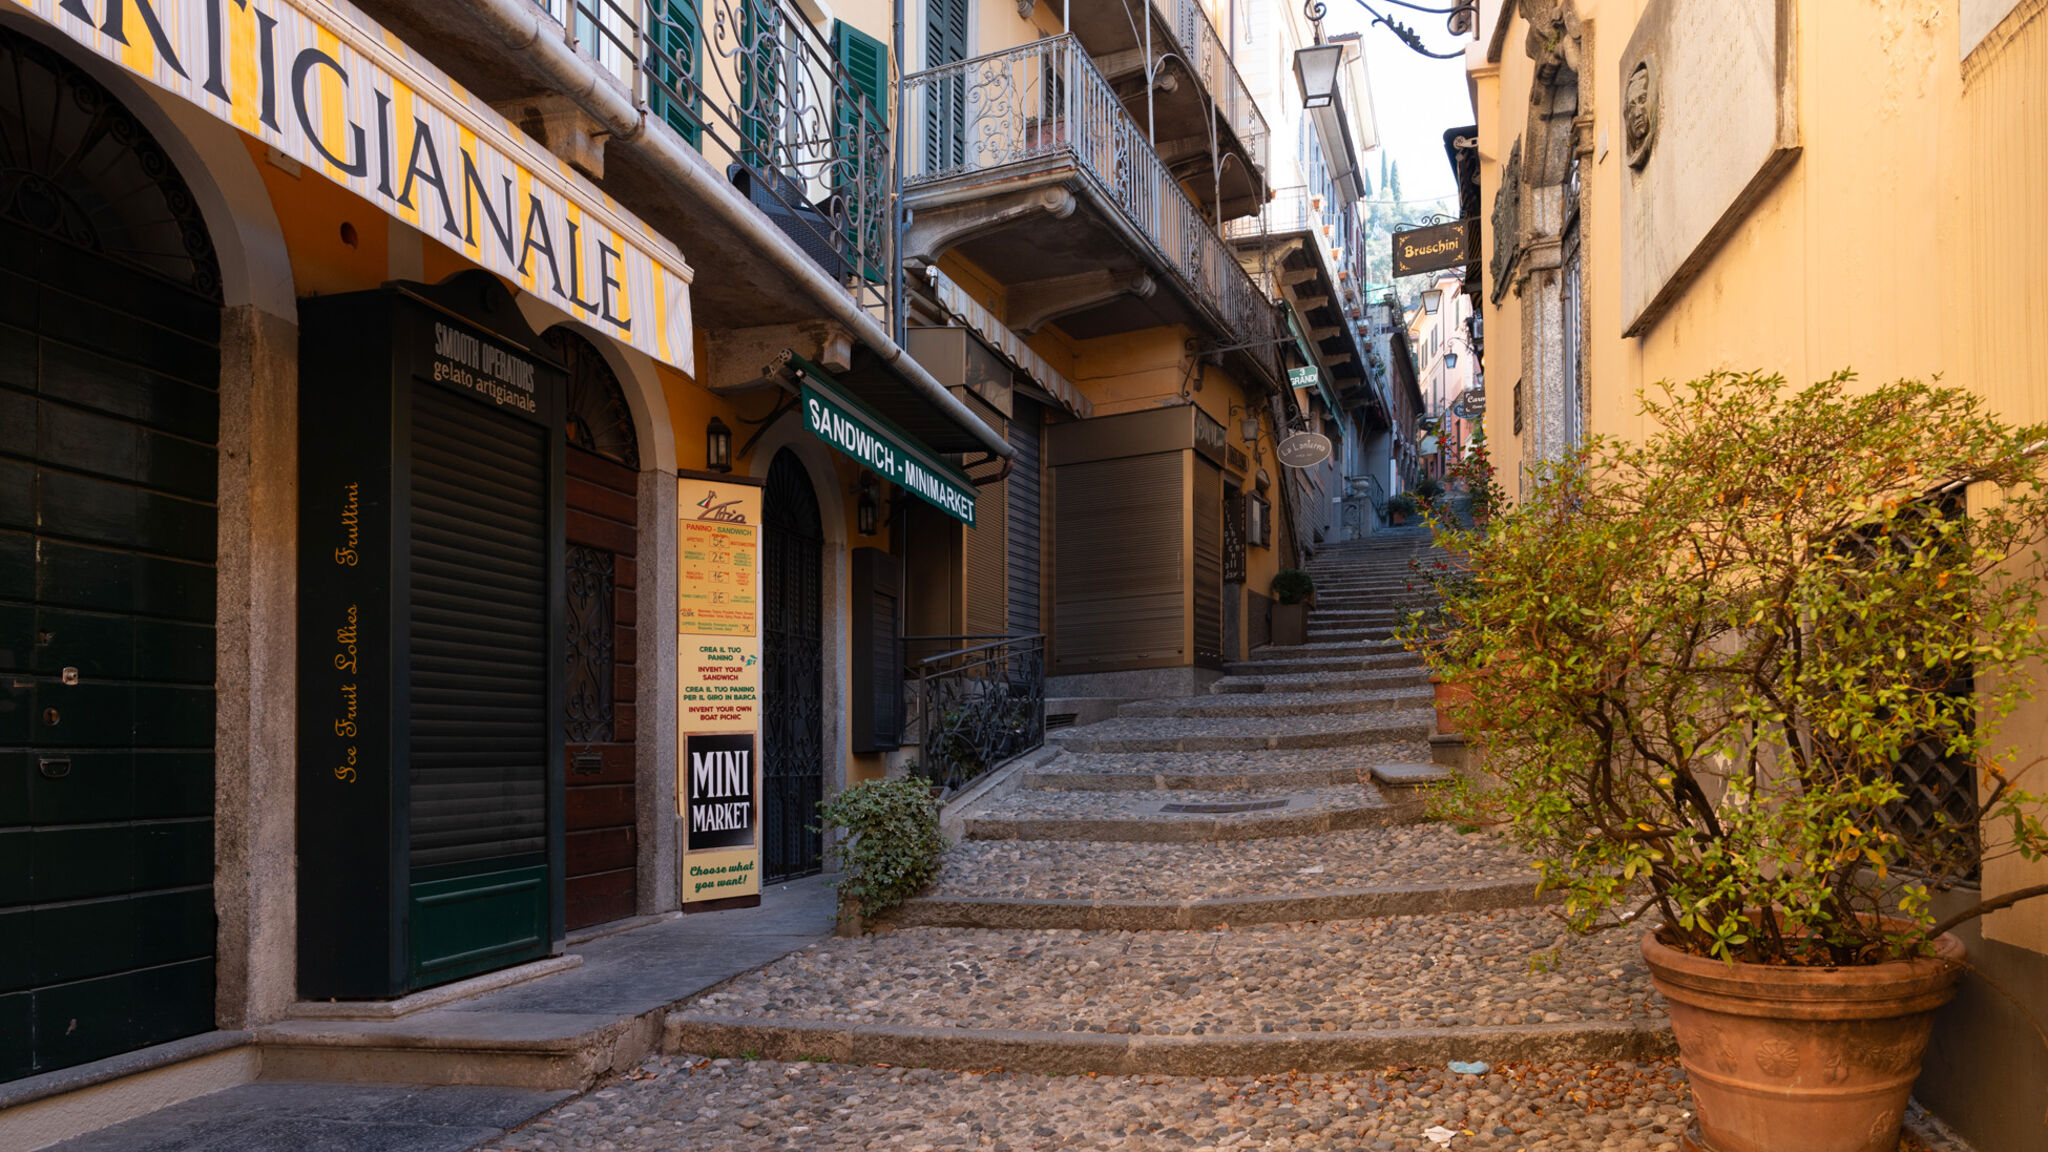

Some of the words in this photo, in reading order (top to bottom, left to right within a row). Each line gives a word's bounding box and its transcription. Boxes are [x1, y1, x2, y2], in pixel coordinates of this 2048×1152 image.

[1404, 238, 1459, 258] Bruschini
[435, 322, 479, 370] SMOOTH
[482, 342, 534, 393] OPERATORS
[434, 361, 473, 388] gelato
[476, 378, 536, 413] artigianale
[809, 398, 894, 476] SANDWICH
[904, 460, 974, 522] MINIMARKET
[335, 481, 359, 567] Fruttini
[686, 524, 712, 532] PANINO
[717, 526, 752, 536] SANDWICH
[334, 604, 358, 673] Lollies
[335, 683, 358, 738] Fruit
[692, 750, 749, 799] MINI
[693, 802, 749, 832] MARKET
[690, 865, 727, 876] Choose
[729, 860, 755, 872] what
[695, 881, 714, 893] you
[717, 874, 747, 887] want!
